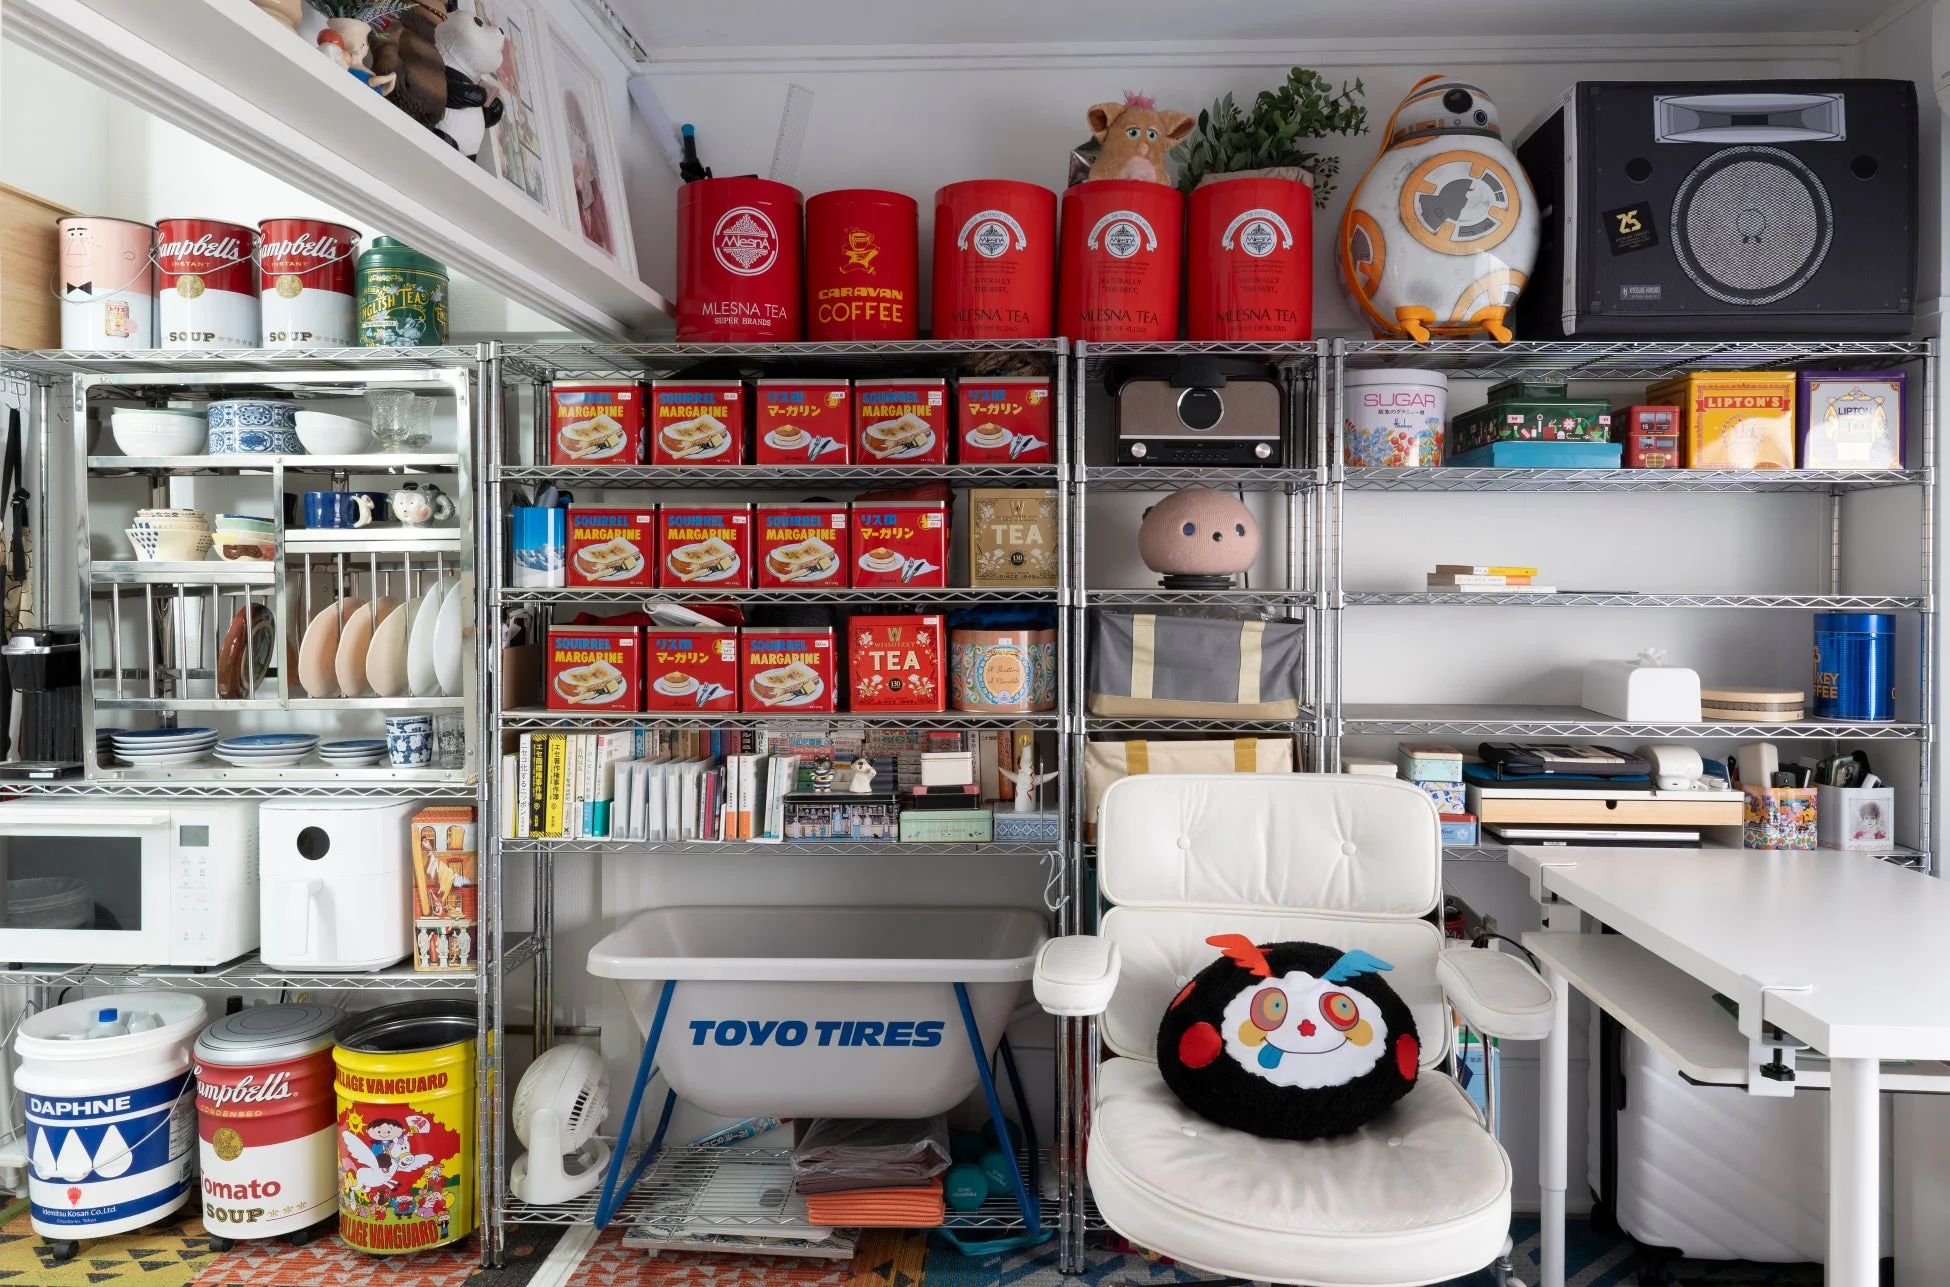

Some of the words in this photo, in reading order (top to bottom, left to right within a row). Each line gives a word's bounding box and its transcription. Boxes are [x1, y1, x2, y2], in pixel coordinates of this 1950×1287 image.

[396, 287, 422, 307] TEA
[817, 286, 903, 301] CARAVAN
[702, 301, 760, 318] MLESNA
[764, 303, 788, 320] TEA
[817, 301, 904, 324] COFFEE
[951, 308, 1002, 323] MLESNA
[1005, 309, 1030, 324] TEA
[1079, 308, 1131, 323] MLESNA
[1135, 310, 1159, 326] TEA
[1215, 308, 1272, 323] MLESNA
[1275, 309, 1298, 324] TEA
[714, 317, 739, 325] SUPER
[742, 318, 772, 327] BRANDS
[169, 331, 216, 343] SOUP
[269, 331, 313, 342] SOUP
[659, 392, 716, 405] SQUIRREL
[862, 391, 920, 405] SQUIRREL
[1363, 392, 1436, 408] SUGAR
[1707, 396, 1780, 408] LIPTON'S
[557, 405, 625, 418] MARGARINE
[659, 405, 728, 418] MARGARINE
[767, 405, 821, 417] マーガリン
[862, 404, 932, 417] MARGARINE
[968, 403, 1023, 415] マーガリン
[1838, 406, 1873, 416] LIPTON
[573, 515, 630, 527] SQUIRREL
[667, 514, 725, 527] SQUIRREL
[765, 515, 824, 527] SQUIRREL
[573, 528, 642, 541] MARGARINE
[667, 528, 737, 541] MARGARINE
[766, 528, 836, 541] MARGARINE
[861, 527, 914, 540] マーガリン
[990, 524, 1044, 545] TEA
[555, 637, 611, 650] SQUIRREL
[750, 639, 808, 652] SQUIRREL
[554, 651, 624, 664] MARGARINE
[655, 652, 709, 664] マーガリン
[749, 652, 820, 665] MARGARINE
[868, 650, 921, 671] TEA
[1815, 672, 1840, 685] KEY
[1814, 686, 1838, 699] FEE
[688, 1019, 809, 1048] TOYO
[813, 1020, 945, 1048] TIRES
[366, 1072, 448, 1096] VANGUARD
[30, 1095, 131, 1116] DAPHNE
[199, 1104, 263, 1118] CONDENSED
[42, 1208, 67, 1218] Idemitsu
[67, 1210, 89, 1218] Kosan
[205, 1202, 265, 1223] SOUP
[369, 1219, 439, 1250] VANGUARD
